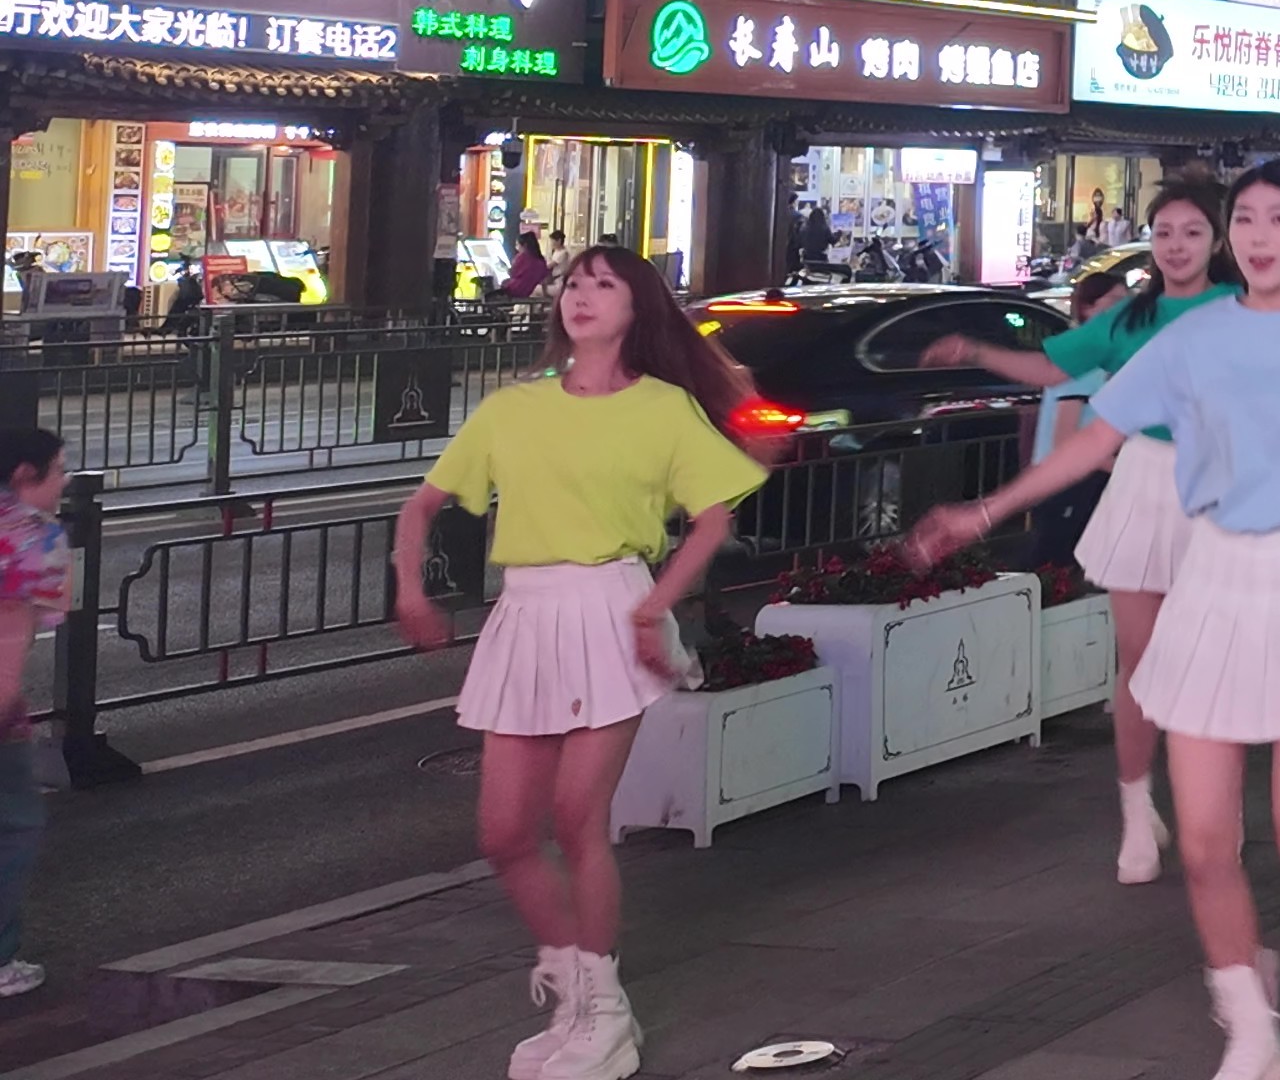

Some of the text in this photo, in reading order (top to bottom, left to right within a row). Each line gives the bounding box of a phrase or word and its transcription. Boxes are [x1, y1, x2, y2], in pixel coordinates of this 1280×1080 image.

[266, 15, 397, 58] 订餐电话2
[412, 7, 513, 42] 韩式料理
[460, 45, 558, 76] 刺身料理
[729, 15, 841, 74] 长寿山
